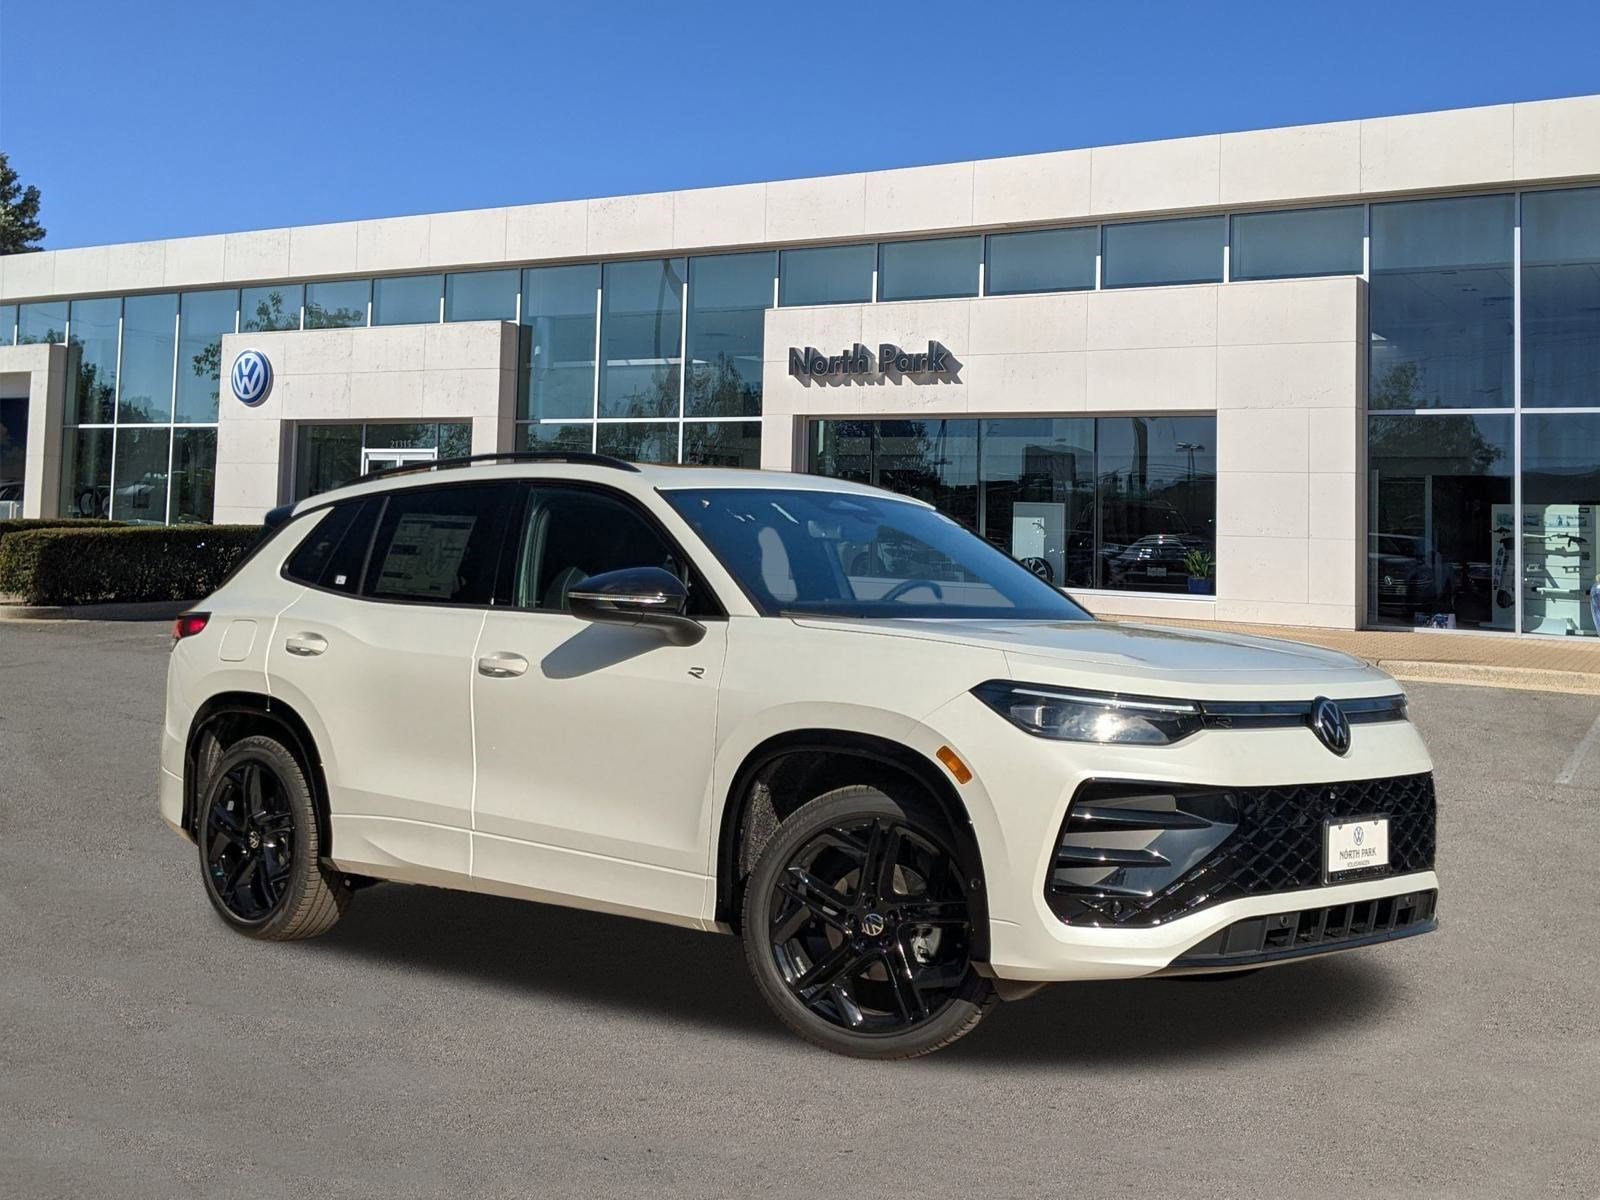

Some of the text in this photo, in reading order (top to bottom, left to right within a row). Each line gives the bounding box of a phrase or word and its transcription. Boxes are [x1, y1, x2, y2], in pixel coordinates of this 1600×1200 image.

[788, 340, 948, 376] North Park
[1339, 847, 1376, 860] NORTH PARK
